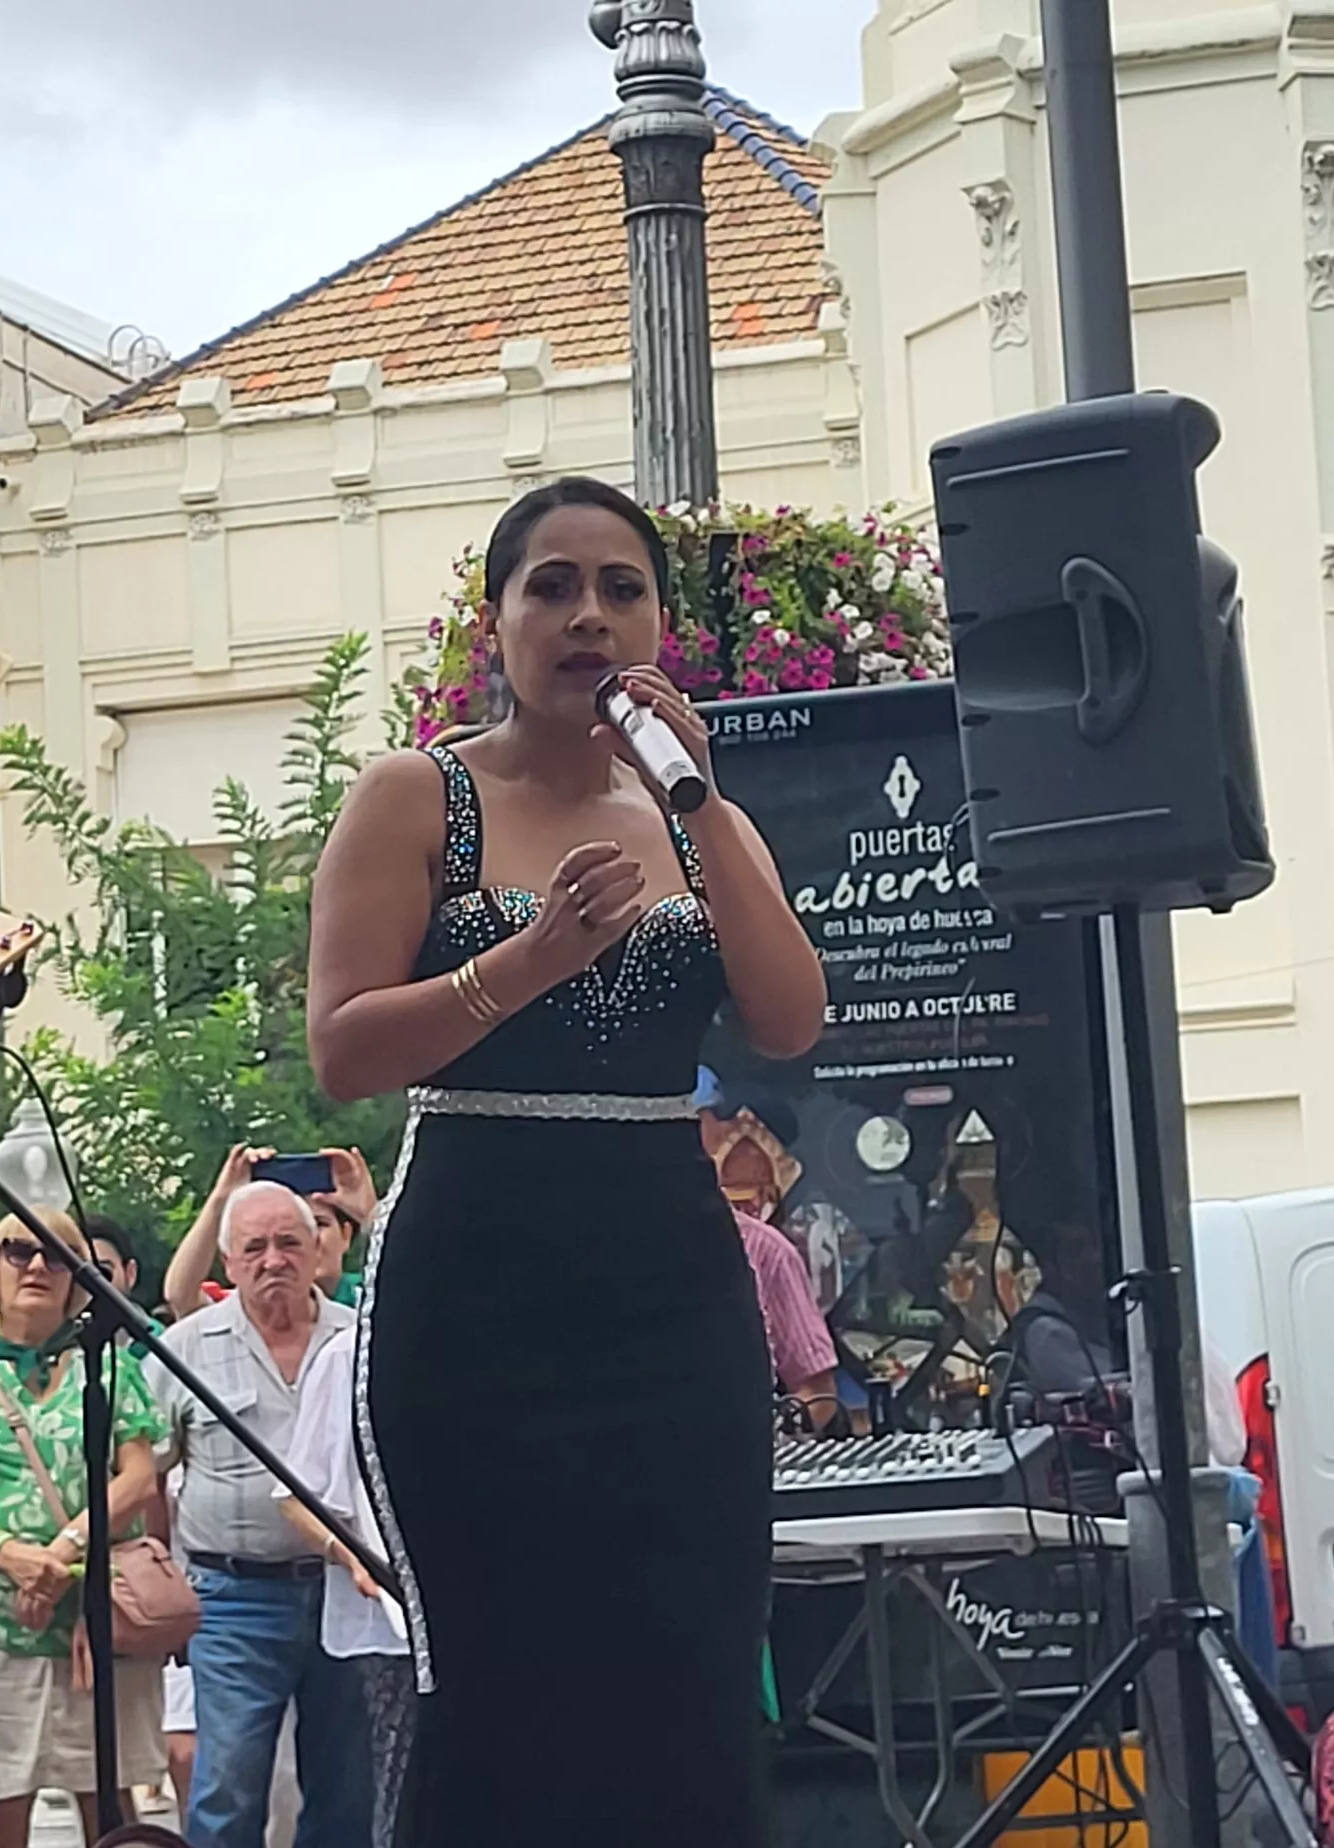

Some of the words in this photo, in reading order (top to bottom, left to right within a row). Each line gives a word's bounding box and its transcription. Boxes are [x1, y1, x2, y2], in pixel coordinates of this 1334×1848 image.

[794, 856, 981, 914] abierta
[823, 919, 845, 937] en
[848, 916, 864, 935] la
[867, 914, 906, 937] hoya
[909, 910, 930, 930] de
[823, 1005, 838, 1023] E
[840, 1000, 901, 1022] JUNIO
[904, 1000, 920, 1018] A
[946, 1577, 1025, 1652] hoya
